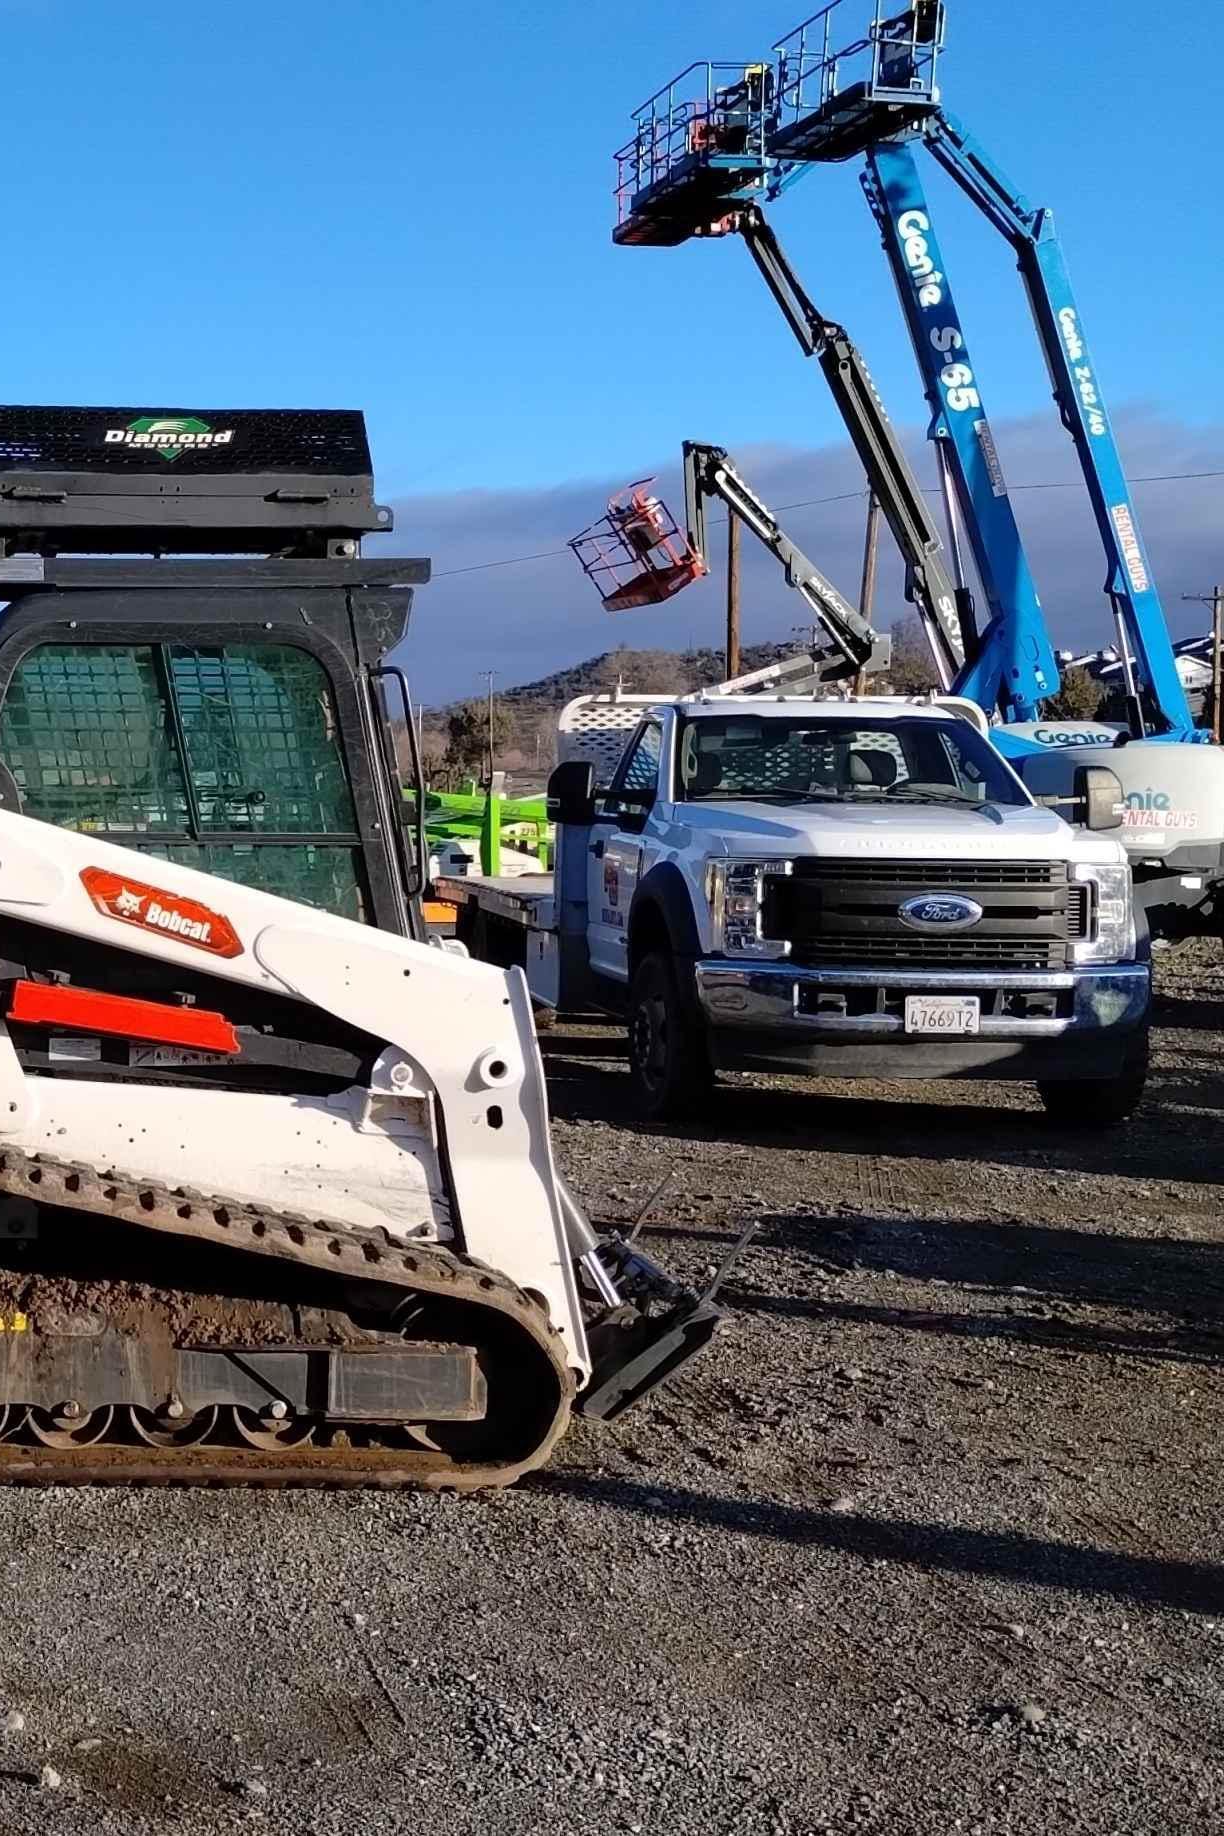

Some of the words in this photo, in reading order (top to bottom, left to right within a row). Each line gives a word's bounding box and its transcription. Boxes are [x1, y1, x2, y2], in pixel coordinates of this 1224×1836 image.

[898, 210, 943, 308] Genie
[930, 326, 980, 412] S-65
[1059, 307, 1082, 363] Genie
[104, 430, 233, 443] Diamond
[1116, 507, 1137, 554] RENTAL
[1128, 557, 1149, 591] GUYS
[1034, 729, 1110, 744] Genie
[1125, 787, 1170, 811] nie
[1122, 810, 1160, 826] ENTAL
[1165, 811, 1196, 828] GUYS
[921, 903, 960, 920] Ford
[145, 902, 211, 943] Bobcat
[911, 1010, 974, 1027] 47669T2
